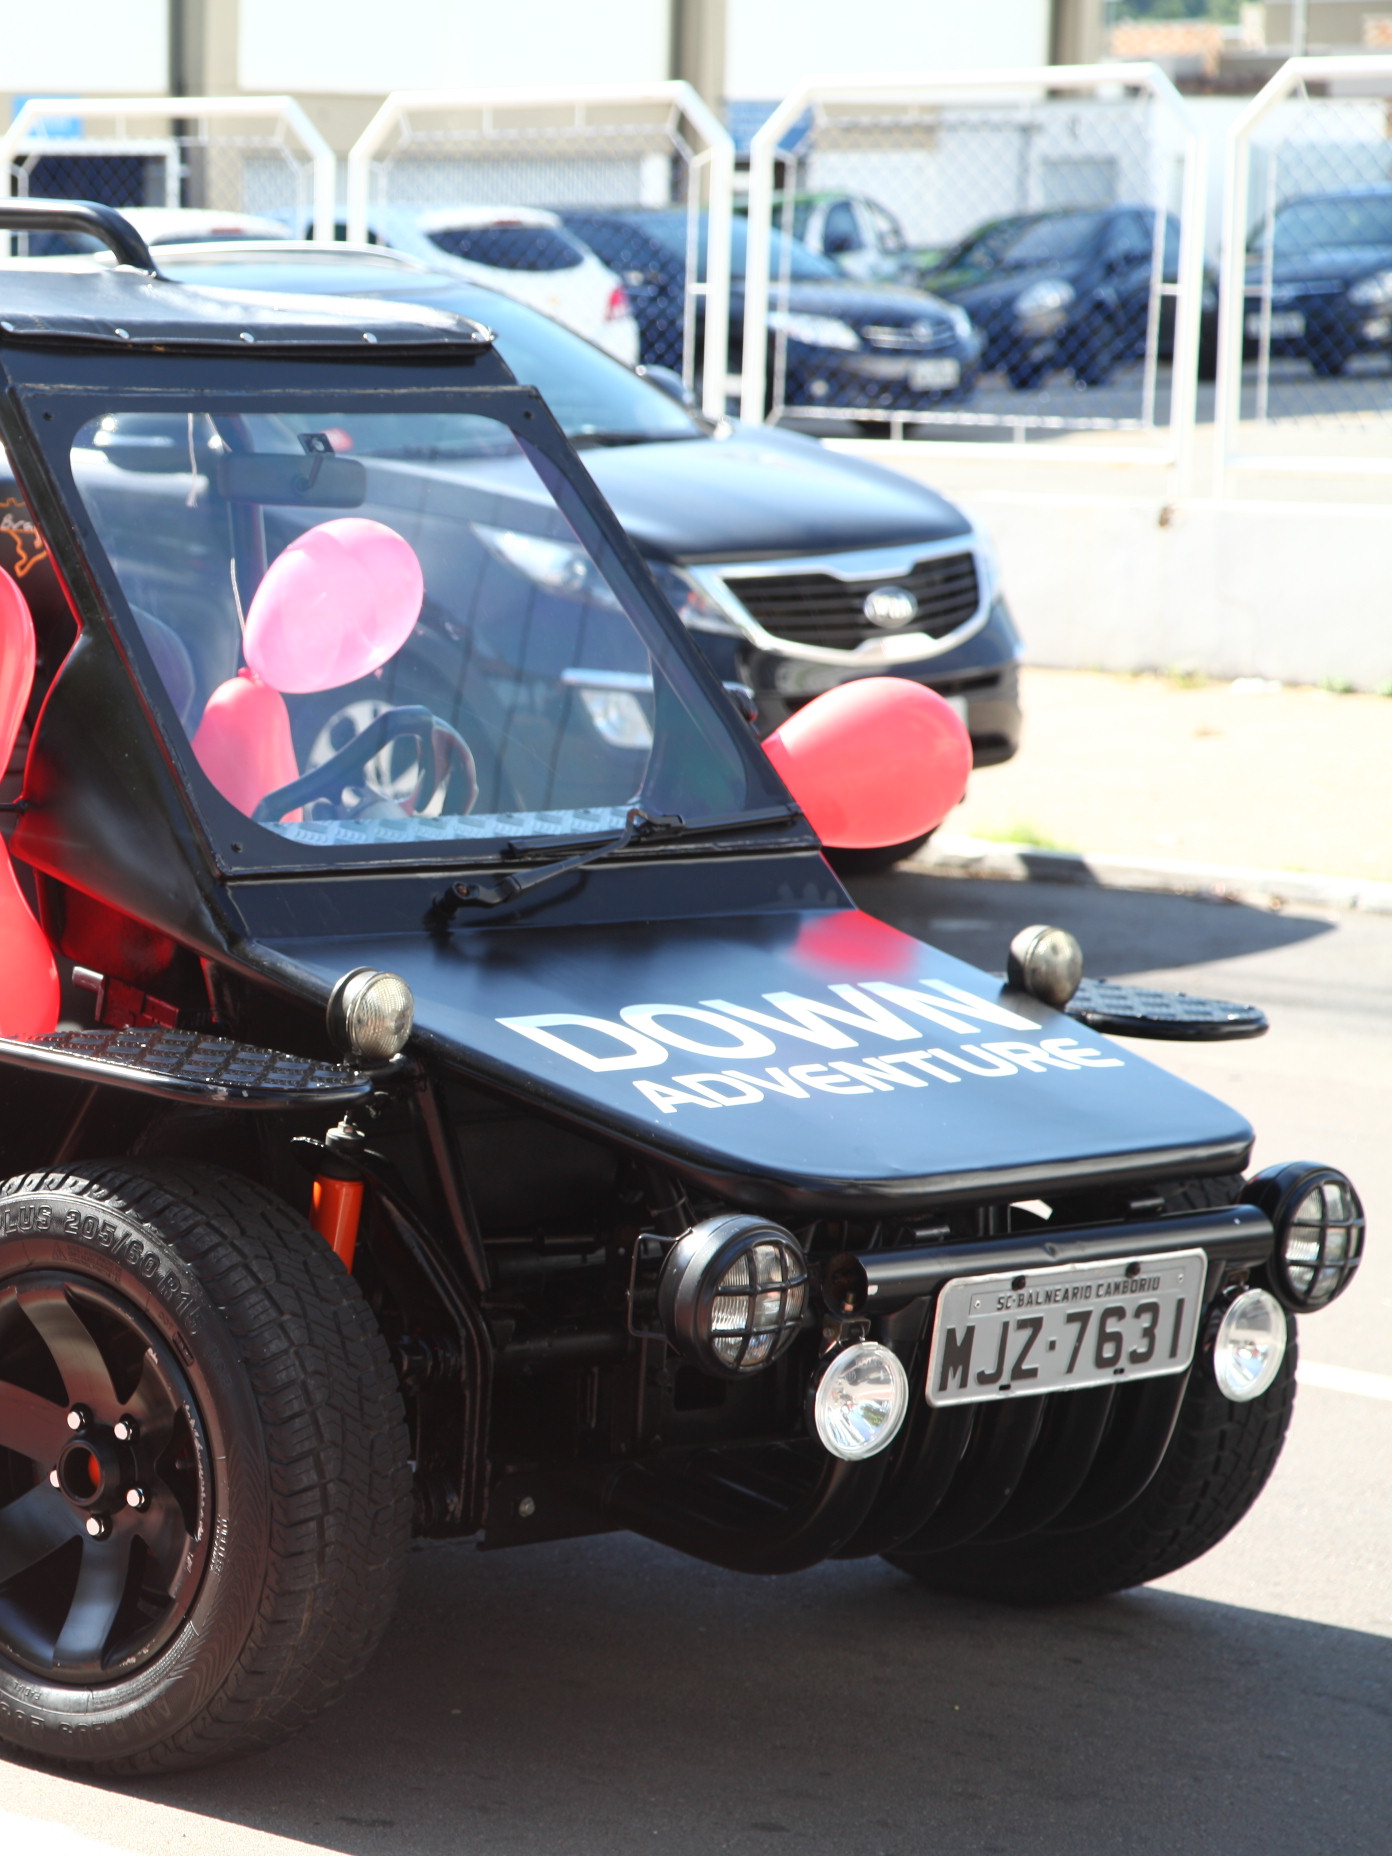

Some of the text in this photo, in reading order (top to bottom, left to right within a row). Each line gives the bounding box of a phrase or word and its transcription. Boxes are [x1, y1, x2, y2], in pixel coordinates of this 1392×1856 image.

[494, 979, 1042, 1073] DOWN
[632, 1038, 1125, 1114] ADVENTURE
[64, 1209, 160, 1278] 205/60
[1096, 1276, 1161, 1299] CAMBORIU
